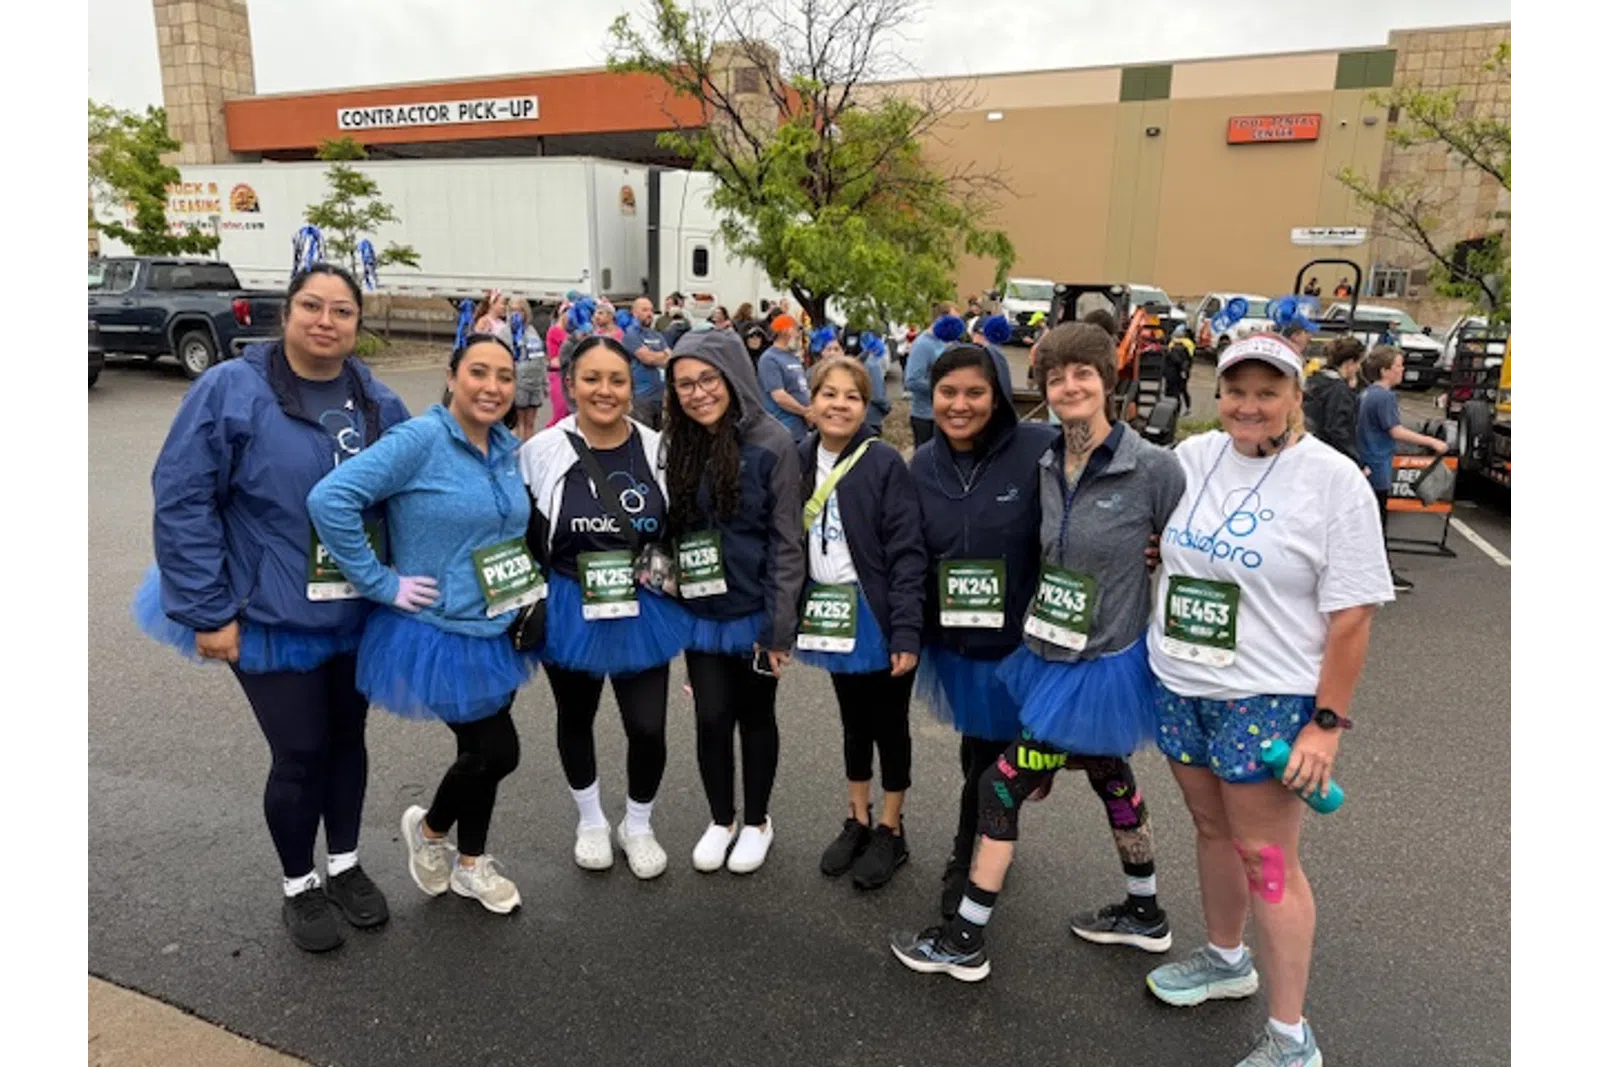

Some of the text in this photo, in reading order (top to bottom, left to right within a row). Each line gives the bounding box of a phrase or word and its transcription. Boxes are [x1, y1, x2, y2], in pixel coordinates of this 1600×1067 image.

[341, 99, 534, 127] CONTRACTOR PICK-UP
[947, 577, 999, 595] PK241
[805, 600, 851, 619] PK252
